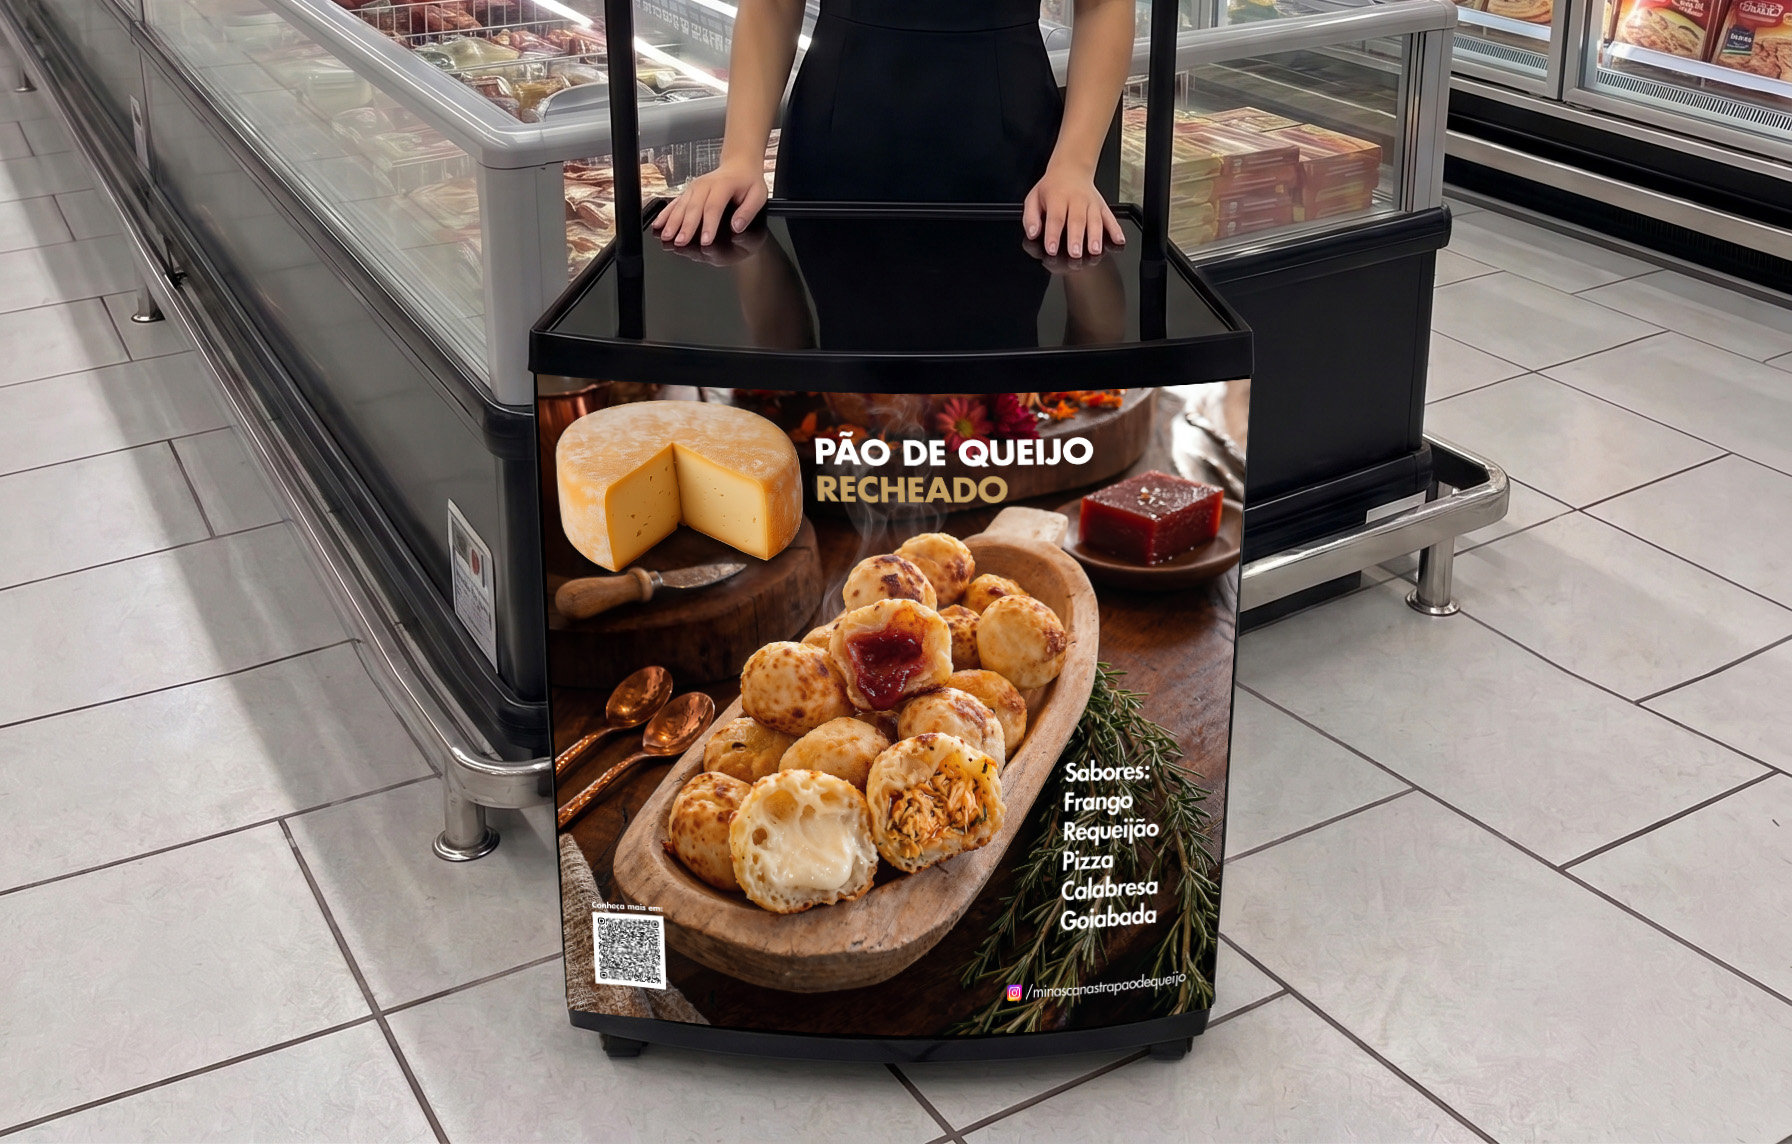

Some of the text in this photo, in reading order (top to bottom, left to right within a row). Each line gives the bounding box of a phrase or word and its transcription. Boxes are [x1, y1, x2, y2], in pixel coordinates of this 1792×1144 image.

[814, 430, 1094, 468] PÃO DE QUEIJO
[816, 475, 1009, 504] RECHEADO
[1064, 760, 1150, 783] Sabores:
[1064, 792, 1134, 816] Frango
[1063, 818, 1160, 846] Requeijão
[1062, 851, 1114, 871] Pizza
[1061, 876, 1159, 901] Calabresa
[1060, 902, 1158, 931] Goiabada
